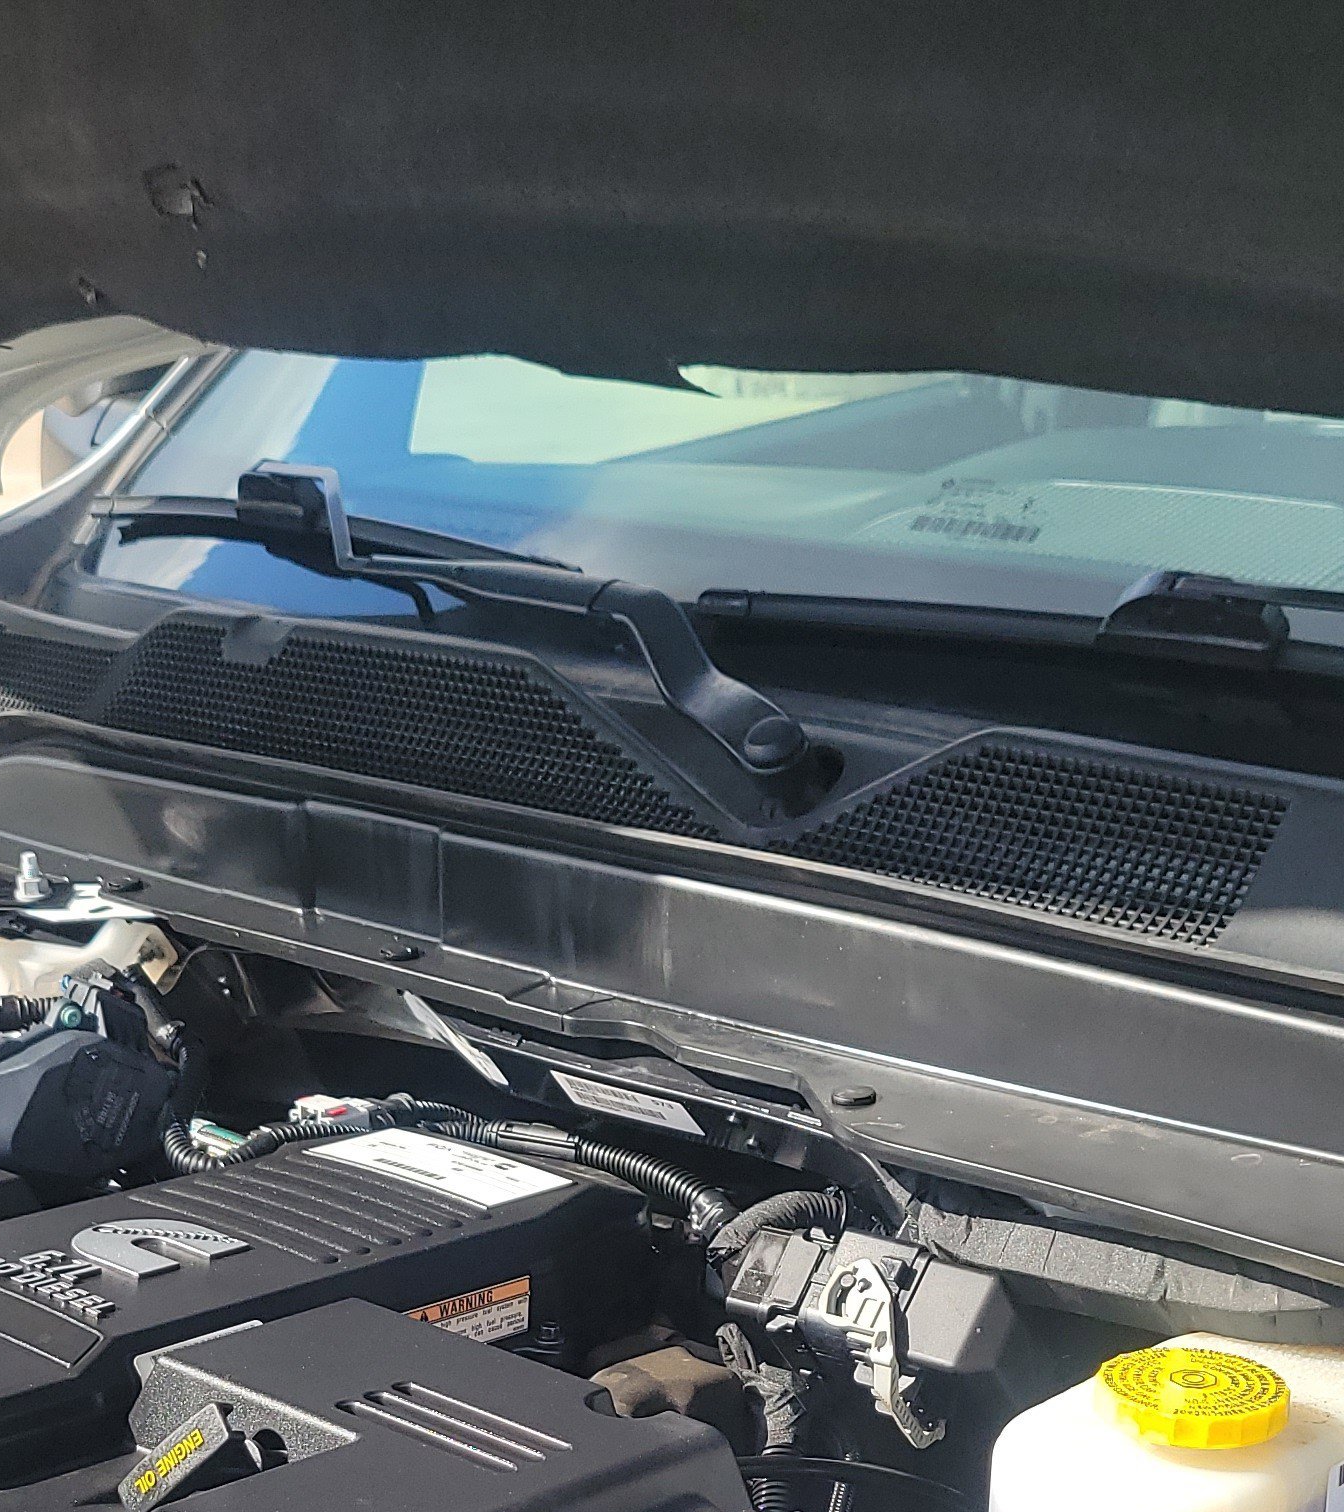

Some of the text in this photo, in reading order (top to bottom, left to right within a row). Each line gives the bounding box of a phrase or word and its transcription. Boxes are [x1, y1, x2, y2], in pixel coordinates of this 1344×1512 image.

[19, 1249, 103, 1284] 6.7L
[10, 1270, 117, 1319] DIESEL
[439, 1290, 494, 1318] WARNING
[134, 1428, 205, 1495] ENGINE OIL
